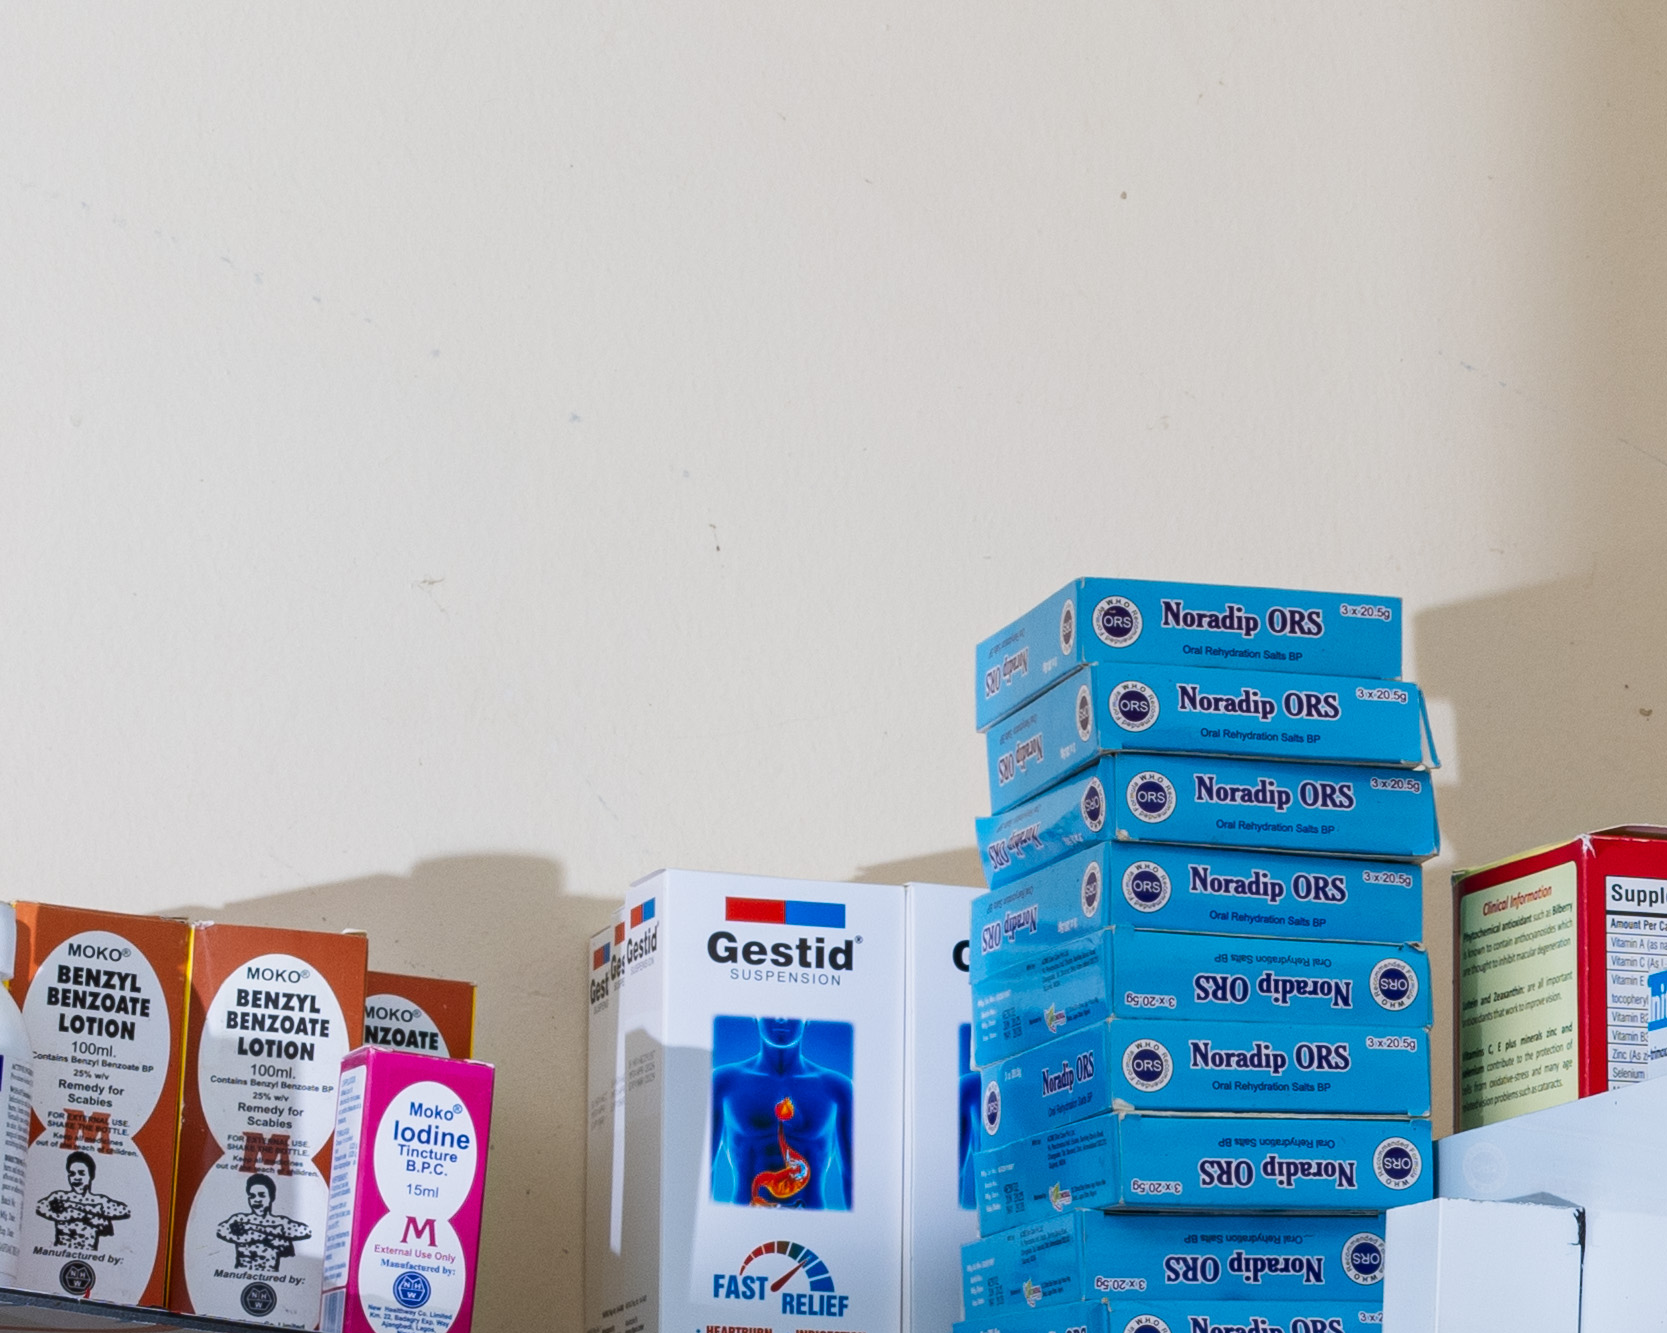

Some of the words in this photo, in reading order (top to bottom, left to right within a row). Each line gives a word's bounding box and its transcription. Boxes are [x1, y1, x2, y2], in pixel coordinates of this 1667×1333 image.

[1102, 614, 1132, 630] ORS
[1161, 600, 1259, 637] Noradip
[1267, 608, 1324, 637] ORS
[1182, 644, 1202, 655] Oral
[1205, 646, 1261, 660] Rehydration
[1264, 650, 1287, 661] Salts
[1288, 651, 1303, 661] BP
[1177, 684, 1276, 720] Noradip
[1283, 693, 1340, 719] ORS
[1194, 774, 1291, 811] Noradip
[1299, 783, 1355, 810] ORS
[1188, 865, 1286, 902] Noradip
[1292, 875, 1348, 903] ORS
[1611, 917, 1642, 931] Amount
[1644, 920, 1656, 932] Per
[57, 964, 142, 994] BENZYL
[730, 968, 841, 987] SUSPENSION
[46, 986, 150, 1018] BENZOATE
[236, 988, 321, 1013] BENZYL
[58, 1013, 135, 1041] LOTION
[226, 1011, 330, 1038] BENZOATE
[71, 1040, 117, 1058] 100ml.
[237, 1036, 315, 1061] LOTION
[1190, 1040, 1287, 1076] Noradip
[1294, 1044, 1351, 1071] ORS
[58, 1078, 102, 1096] Remedy
[105, 1083, 125, 1097] for
[67, 1094, 113, 1109] Scabies
[394, 1120, 471, 1150] Iodine
[397, 1143, 458, 1163] Tincture
[406, 1160, 448, 1177] B.P.C.
[1198, 1158, 1254, 1187] ORS
[1262, 1155, 1357, 1189] Noradip
[406, 1183, 439, 1199] 15ml
[374, 1244, 414, 1258] External
[417, 1249, 433, 1260] Use
[435, 1251, 456, 1263] Only
[214, 1268, 284, 1284] Manufactured
[287, 1274, 306, 1287] by:
[713, 1274, 769, 1300] FAST
[781, 1293, 849, 1317] RELIEF
